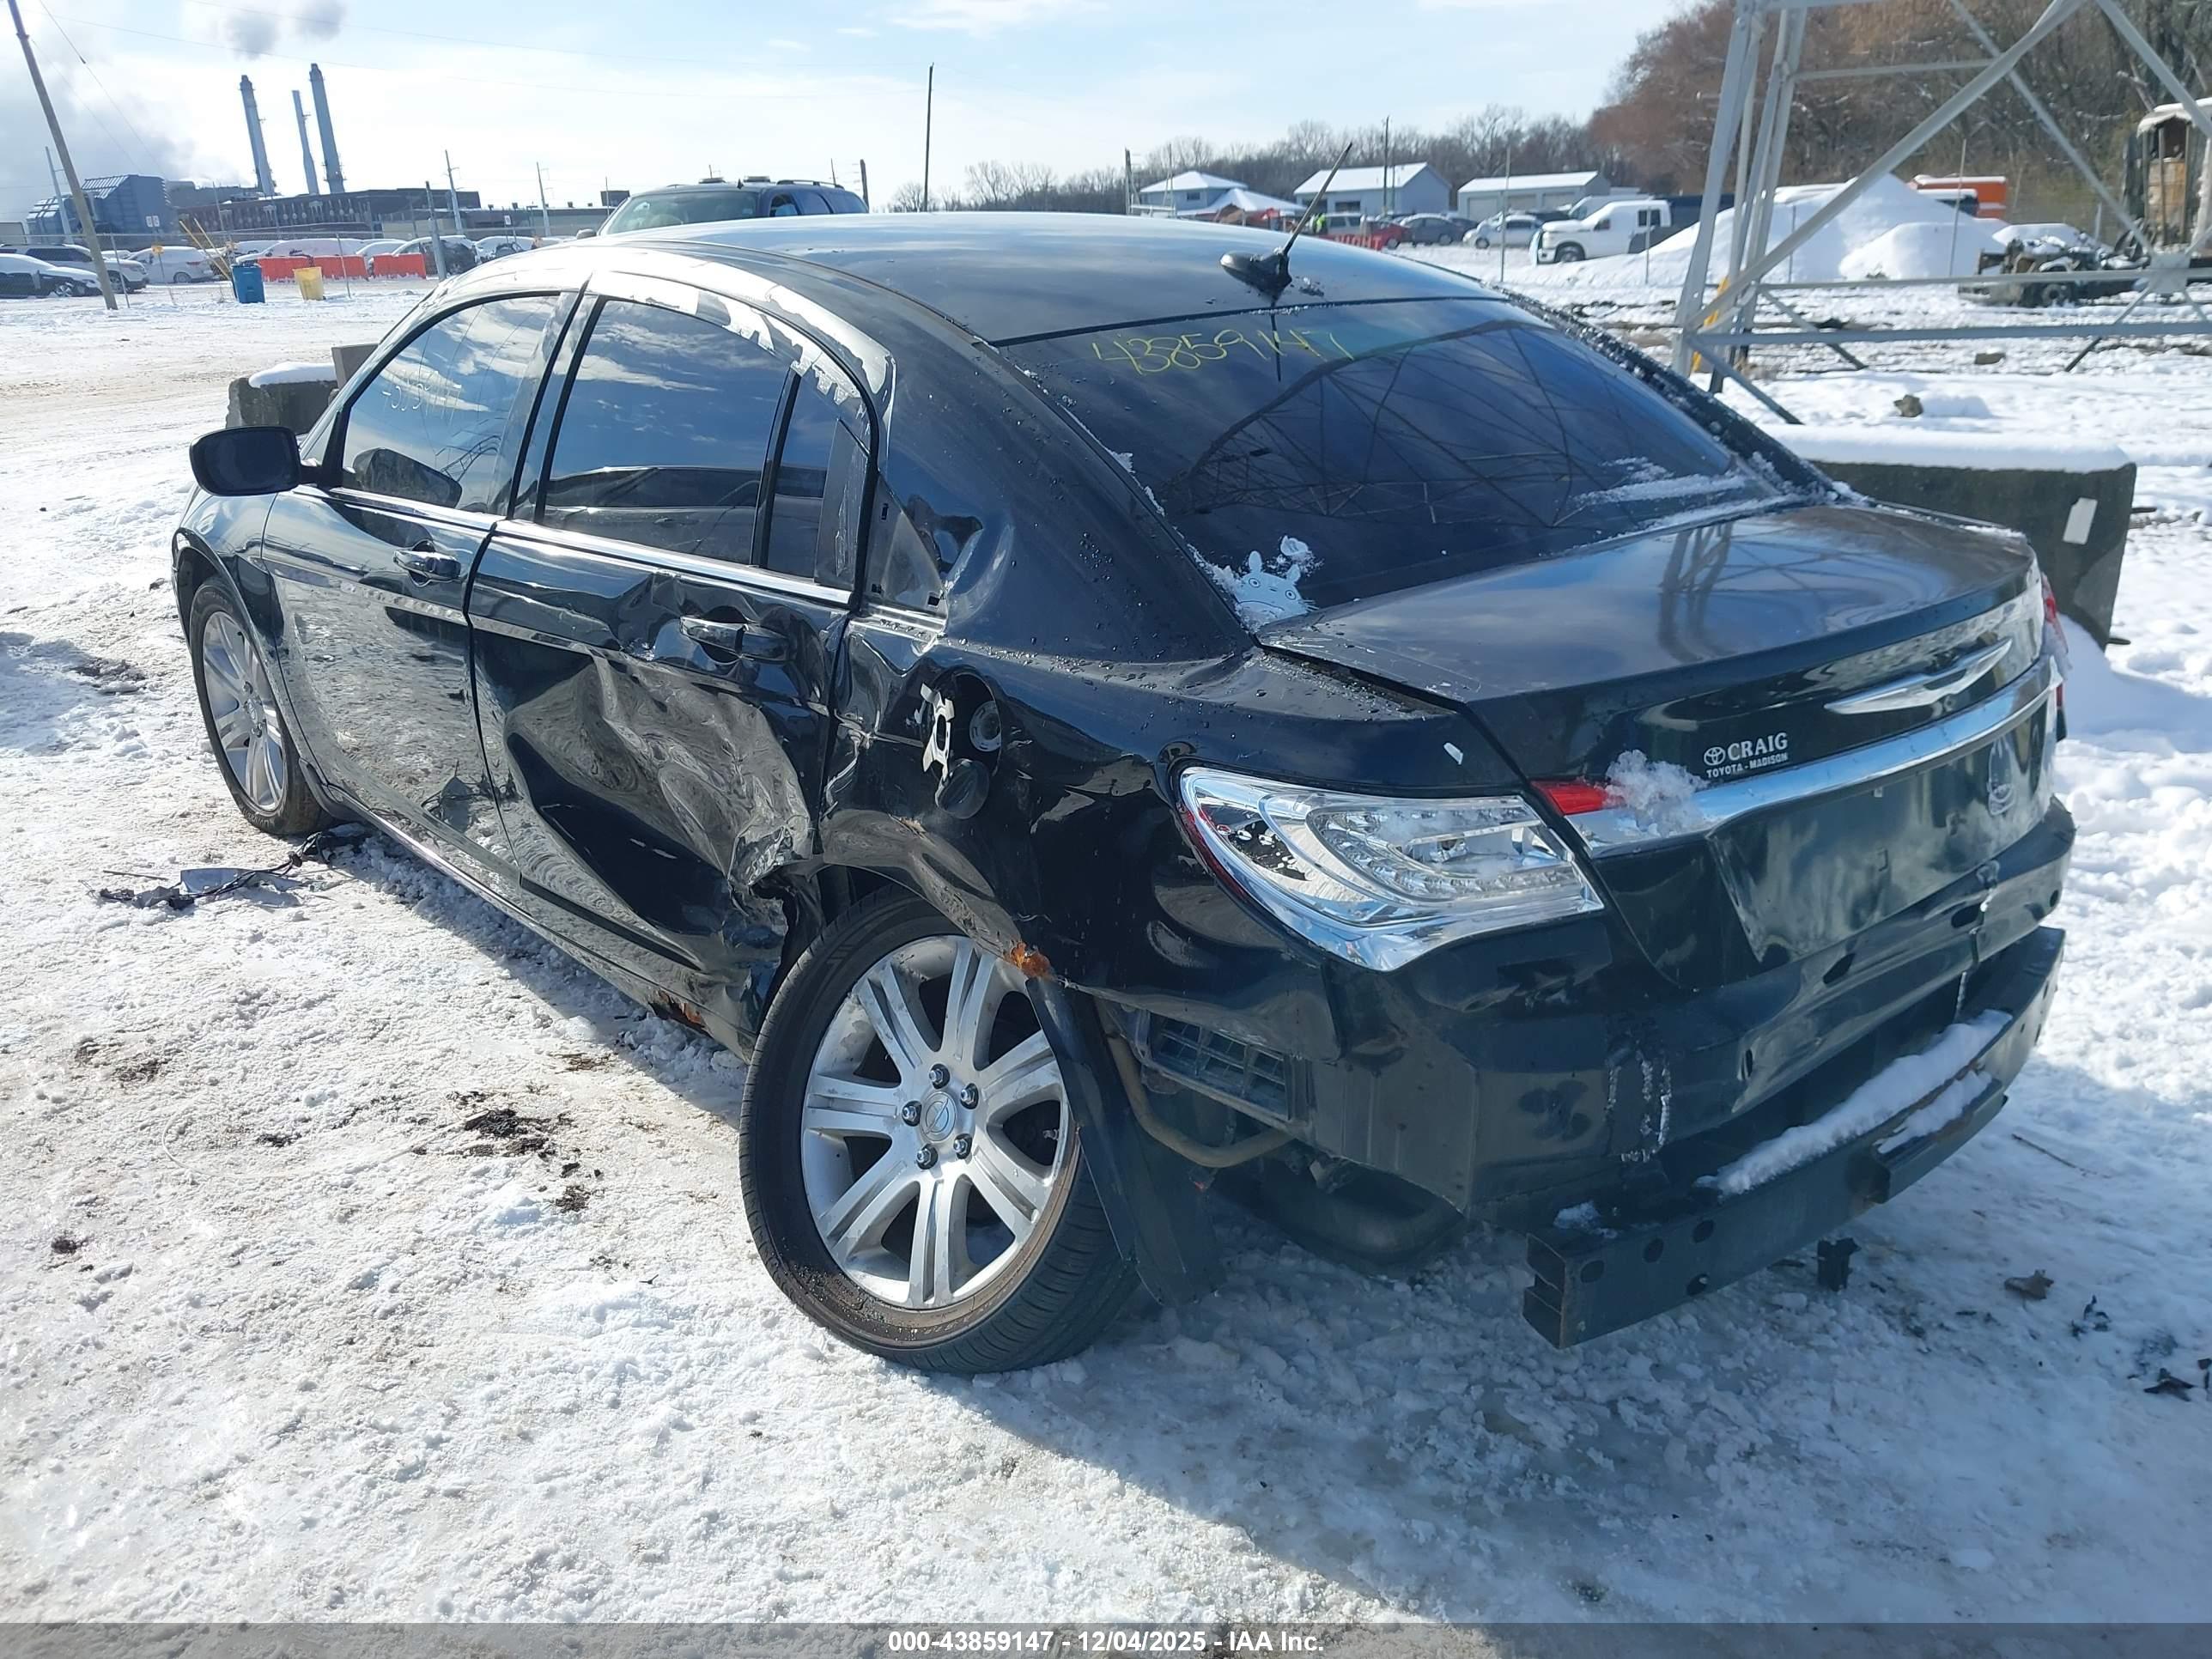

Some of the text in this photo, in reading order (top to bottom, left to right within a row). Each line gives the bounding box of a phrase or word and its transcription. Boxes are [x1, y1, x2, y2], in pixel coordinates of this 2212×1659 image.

[1728, 732, 1788, 761] CRAIG
[1706, 763, 1743, 778] TOYOTA
[1750, 752, 1788, 769] MADISON
